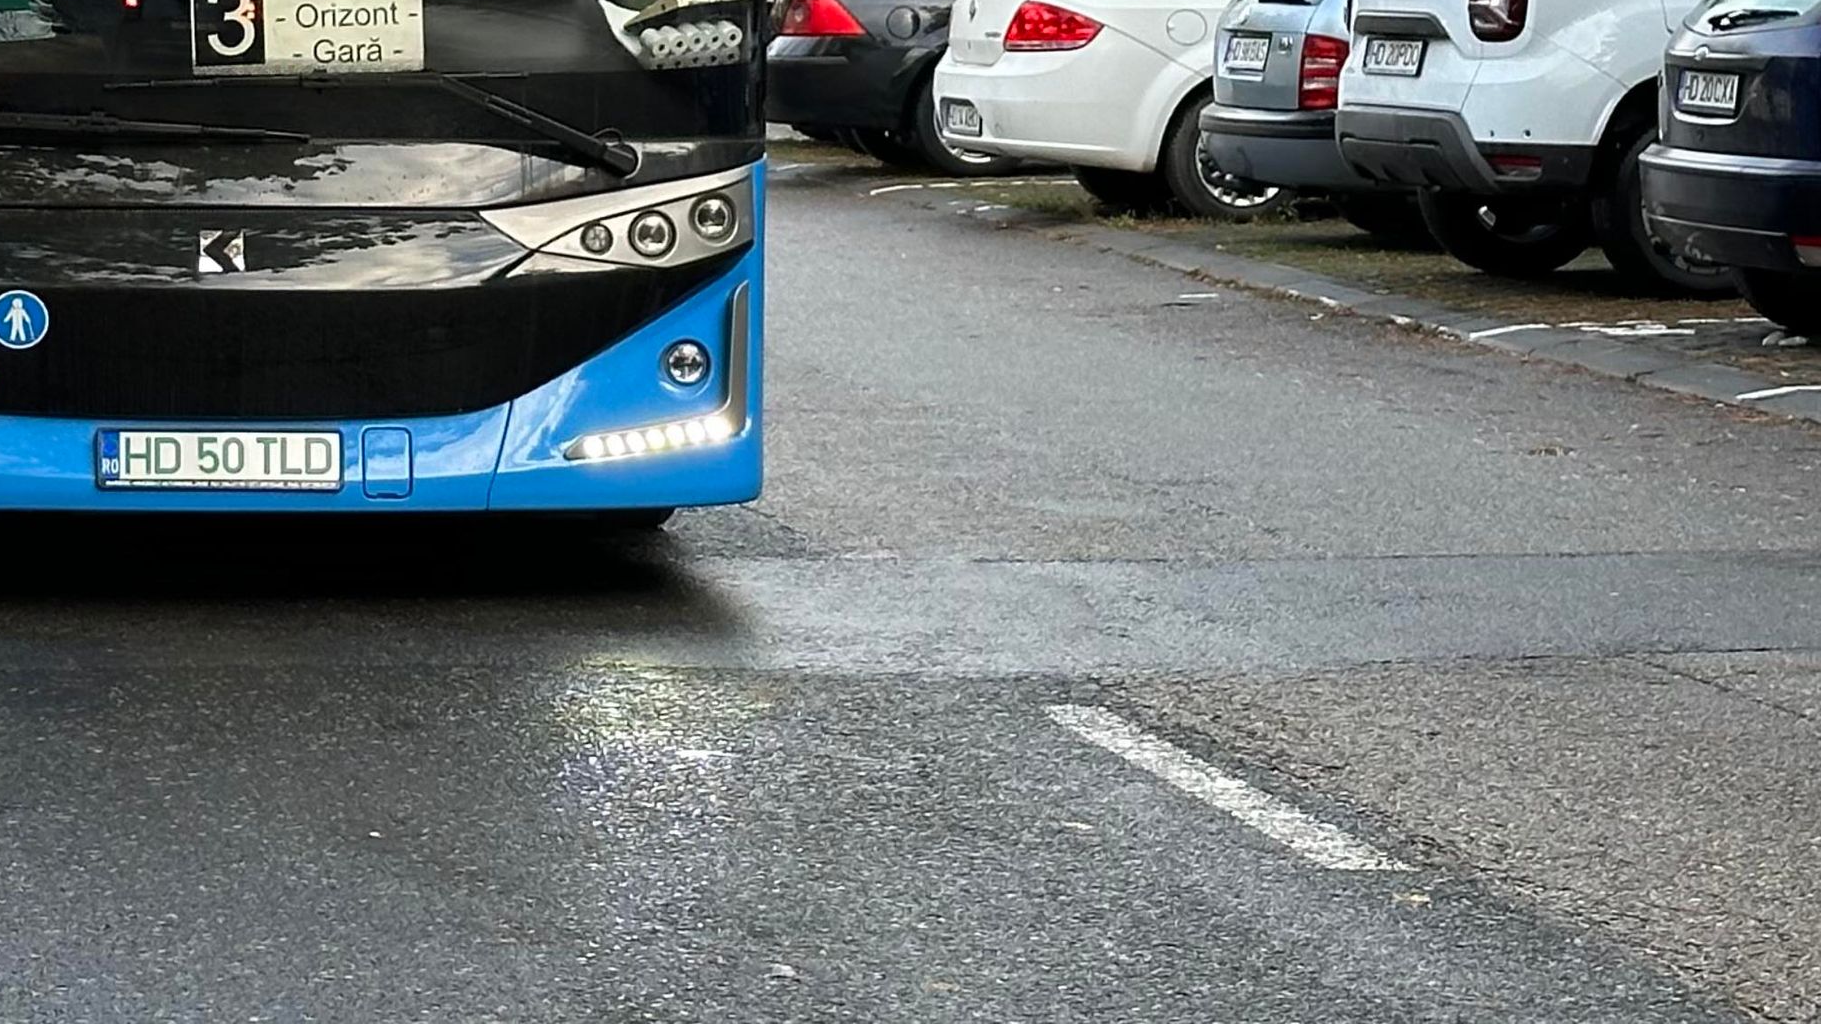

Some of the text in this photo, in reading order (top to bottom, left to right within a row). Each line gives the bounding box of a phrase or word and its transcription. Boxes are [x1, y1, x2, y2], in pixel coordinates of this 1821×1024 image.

[295, 1, 400, 29] Orizont
[312, 36, 383, 64] Gară
[1699, 76, 1714, 102] 20
[102, 437, 332, 474] RO HD 50 TLD
